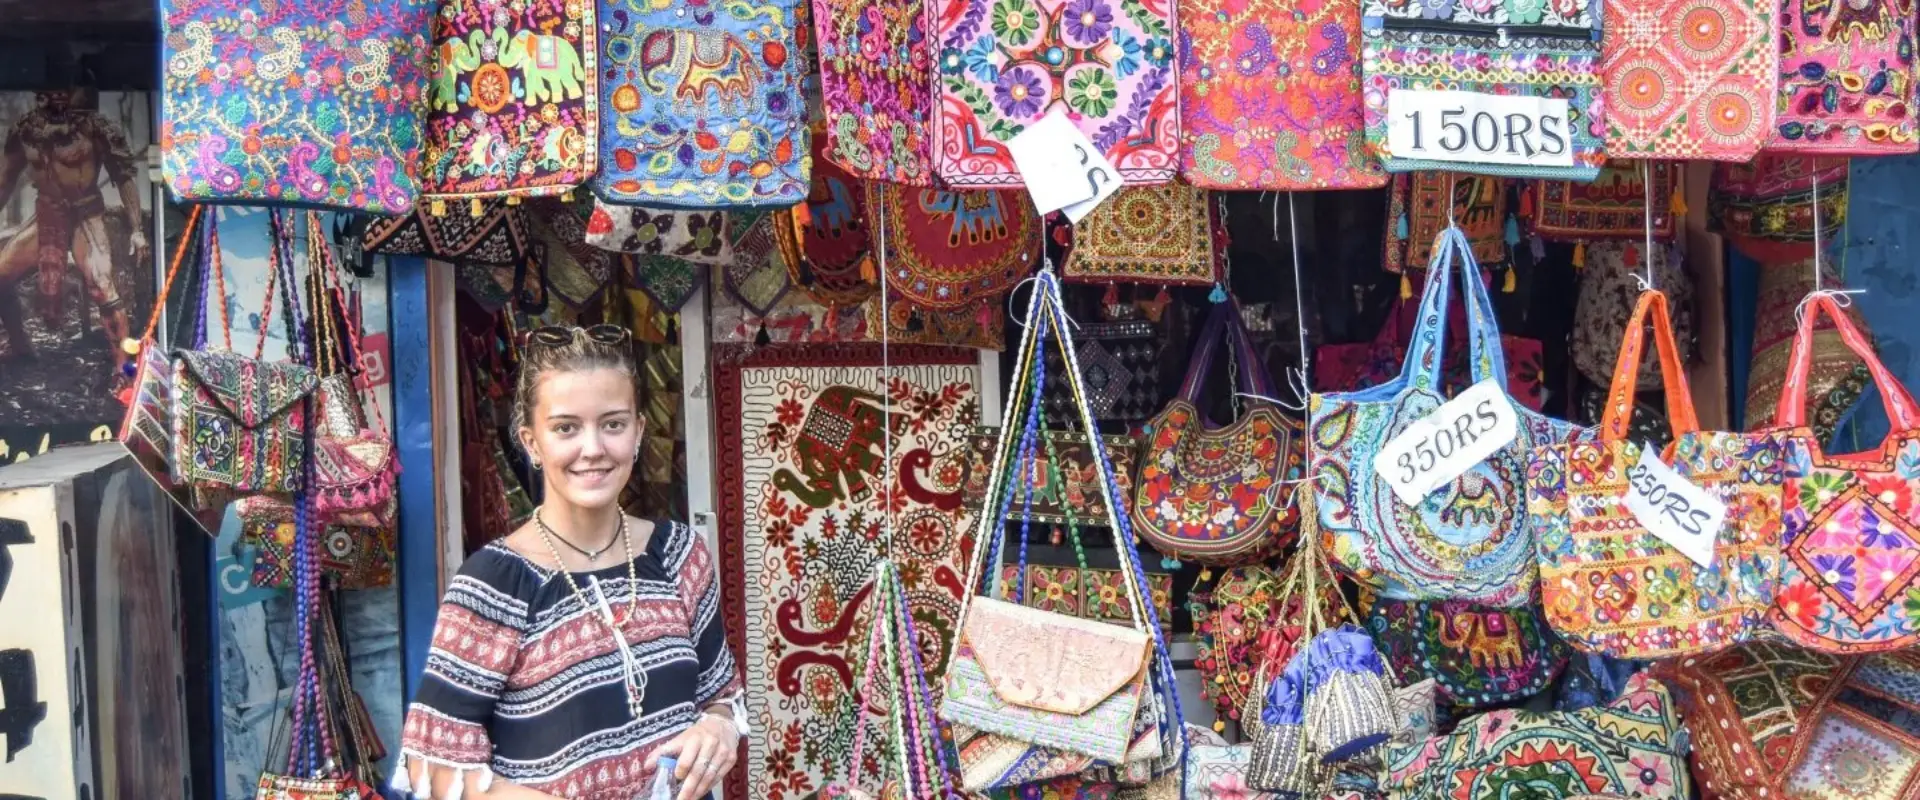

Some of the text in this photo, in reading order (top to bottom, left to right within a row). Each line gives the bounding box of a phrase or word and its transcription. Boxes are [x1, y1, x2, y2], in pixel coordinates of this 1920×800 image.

[1405, 105, 1567, 159] 150RS
[1396, 399, 1499, 484] 350RS
[1631, 463, 1711, 535] 250RS
